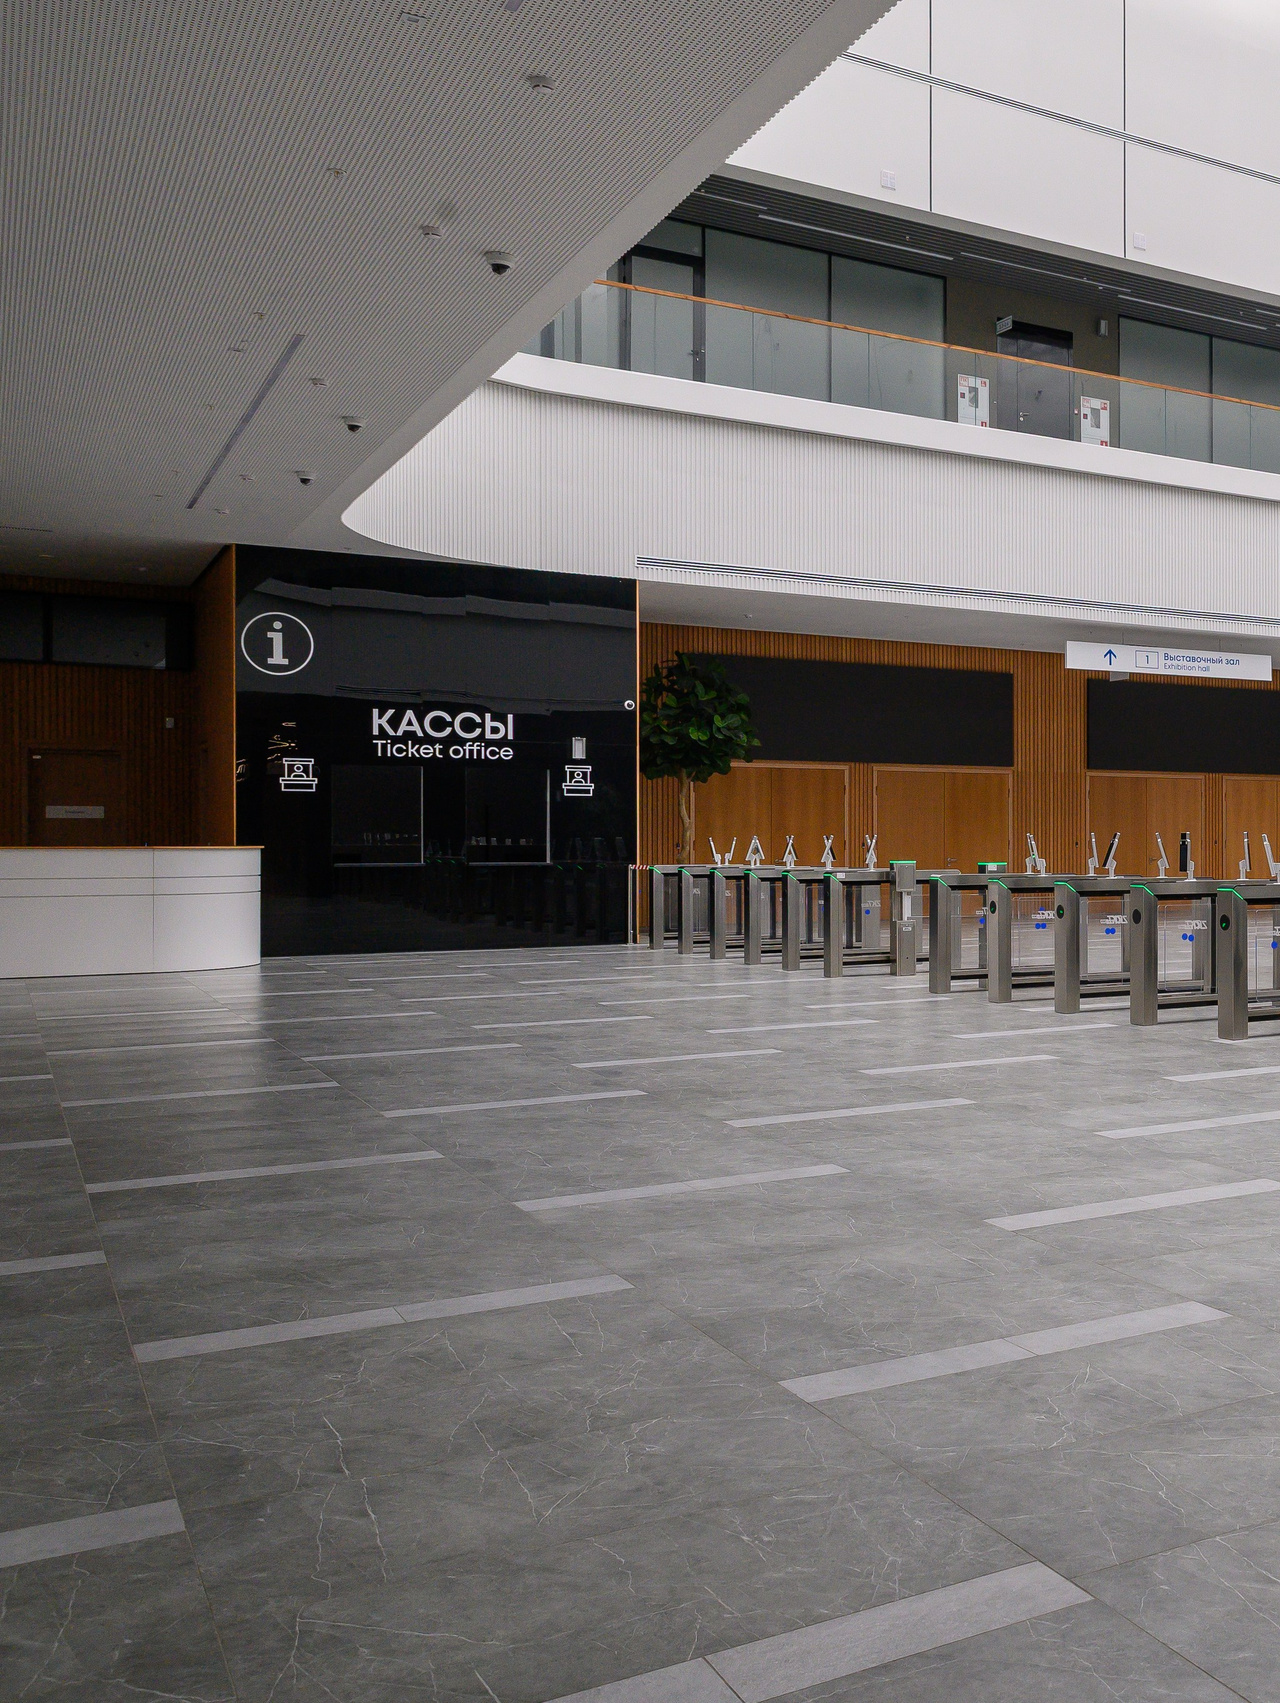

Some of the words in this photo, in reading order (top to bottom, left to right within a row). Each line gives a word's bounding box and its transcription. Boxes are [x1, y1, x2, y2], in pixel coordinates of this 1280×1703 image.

[1145, 655, 1150, 665] 1
[1163, 652, 1223, 665] Выставочный
[1225, 657, 1240, 666] зал
[1163, 663, 1197, 671] Exhibition
[1197, 664, 1211, 672] hall
[372, 708, 514, 740] КАССЫ
[372, 740, 443, 759] Ticket
[449, 742, 514, 761] office
